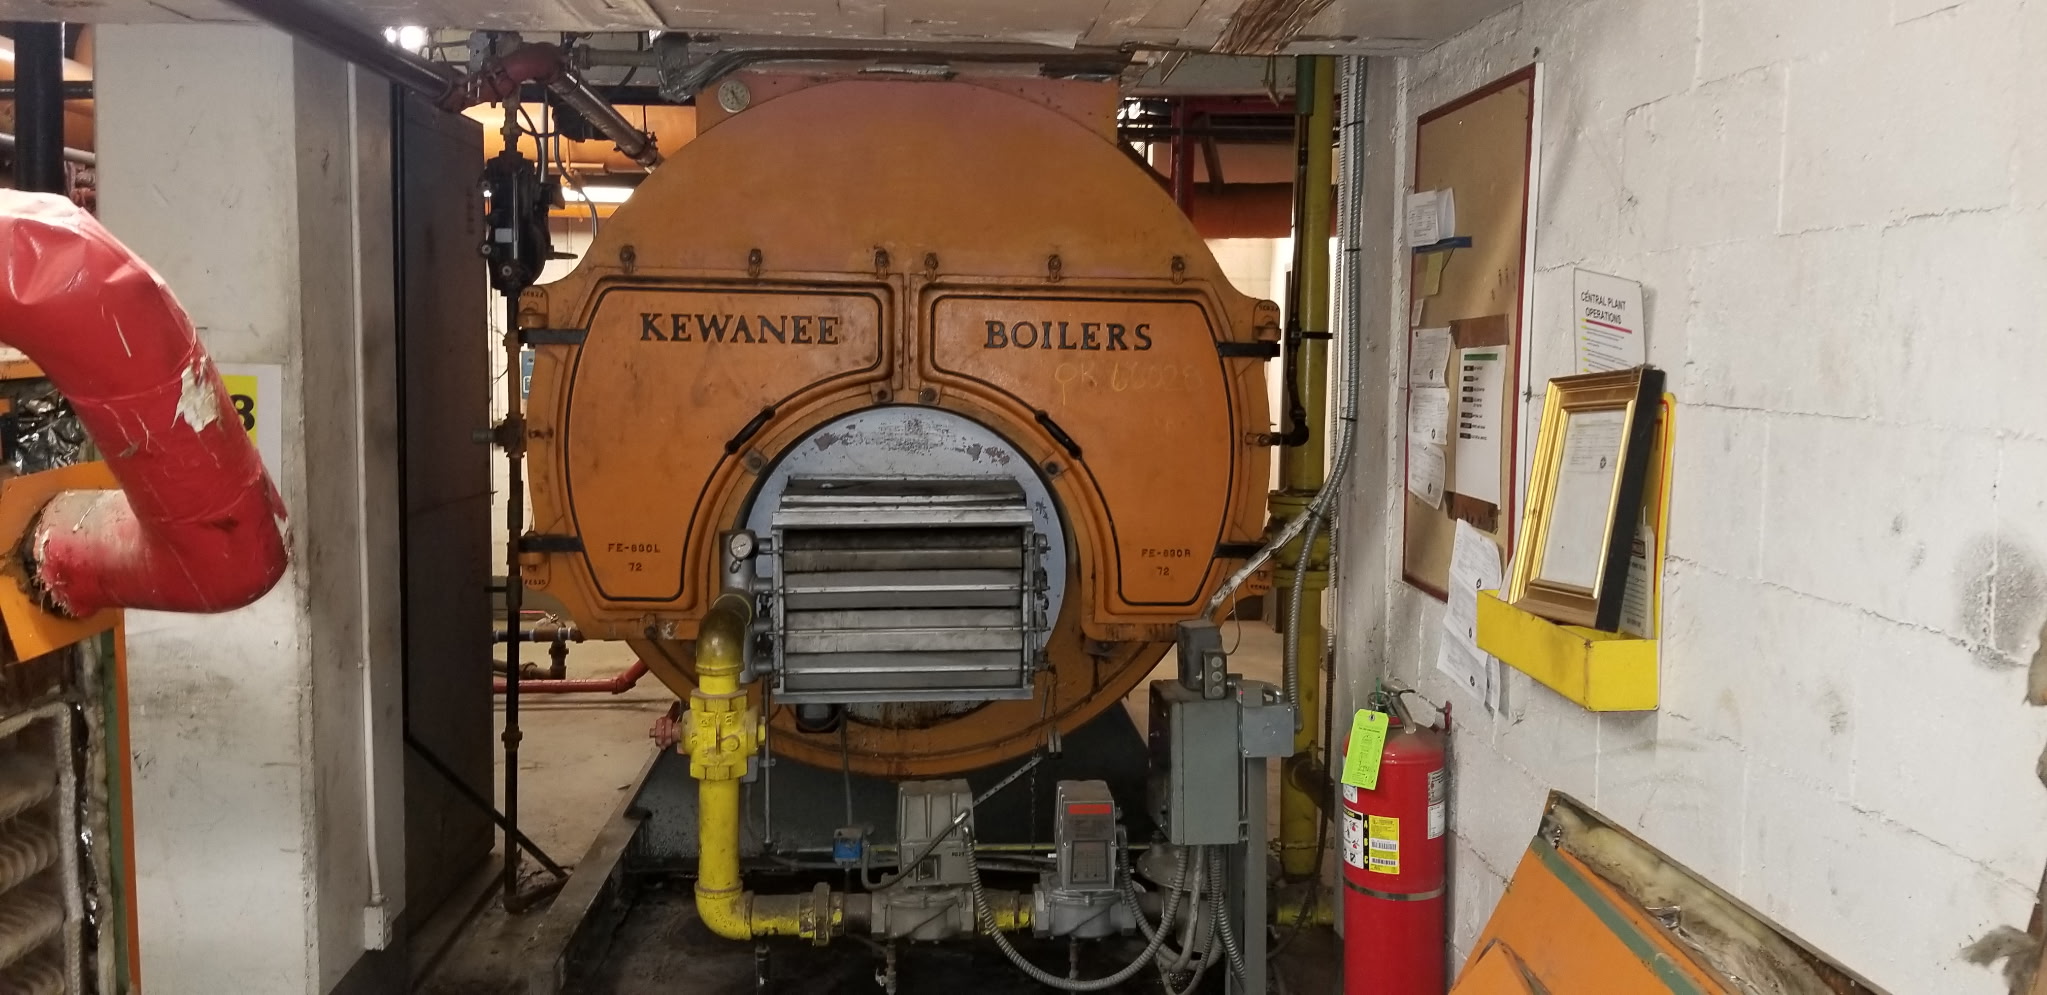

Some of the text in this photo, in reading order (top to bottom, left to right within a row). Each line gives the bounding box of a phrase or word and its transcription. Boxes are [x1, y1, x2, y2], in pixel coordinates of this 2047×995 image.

[1581, 291, 1626, 310] CENTRAL PLANT
[1585, 307, 1622, 324] OPERATIONS
[640, 312, 839, 345] KEWANEE
[983, 320, 1152, 351] BOILERS
[628, 562, 643, 572] 72
[1156, 566, 1170, 576] 72
